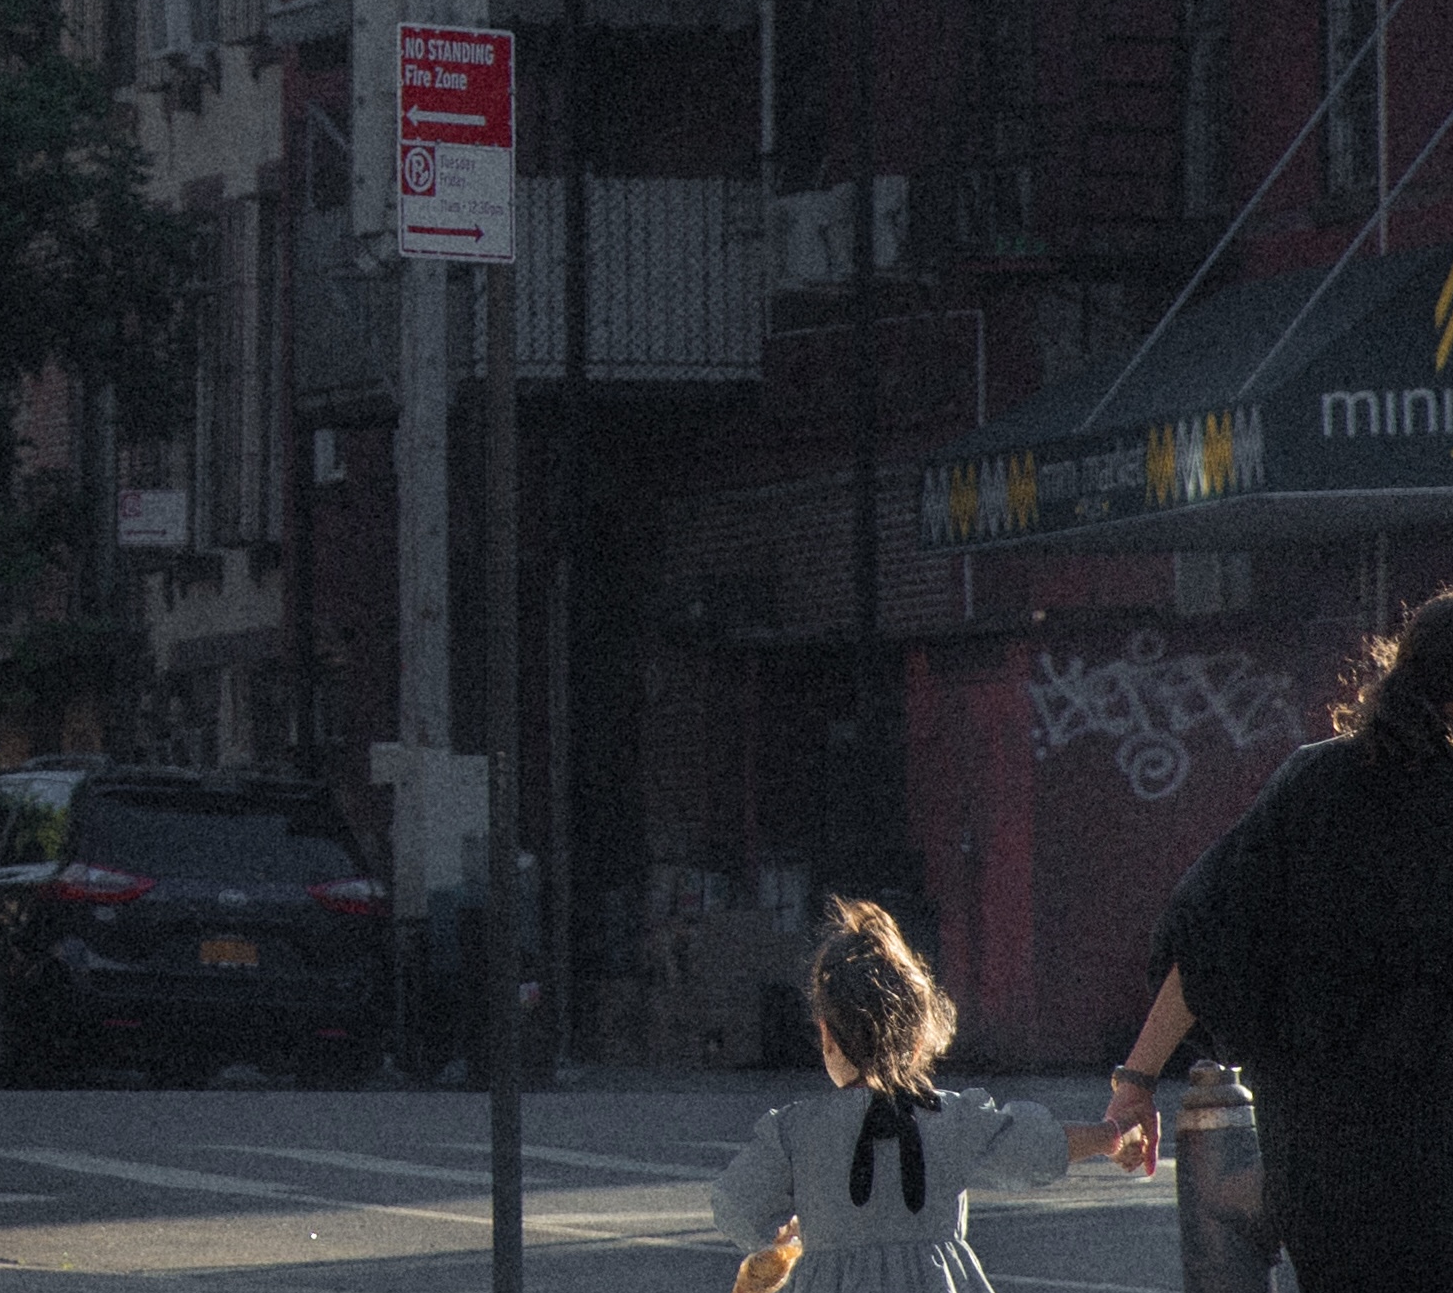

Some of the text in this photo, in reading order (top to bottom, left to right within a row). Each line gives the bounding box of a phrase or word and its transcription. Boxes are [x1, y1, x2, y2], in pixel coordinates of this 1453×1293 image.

[405, 38, 494, 65] NO STANDING
[404, 64, 467, 91] Fire Zone
[1321, 386, 1453, 438] mini
